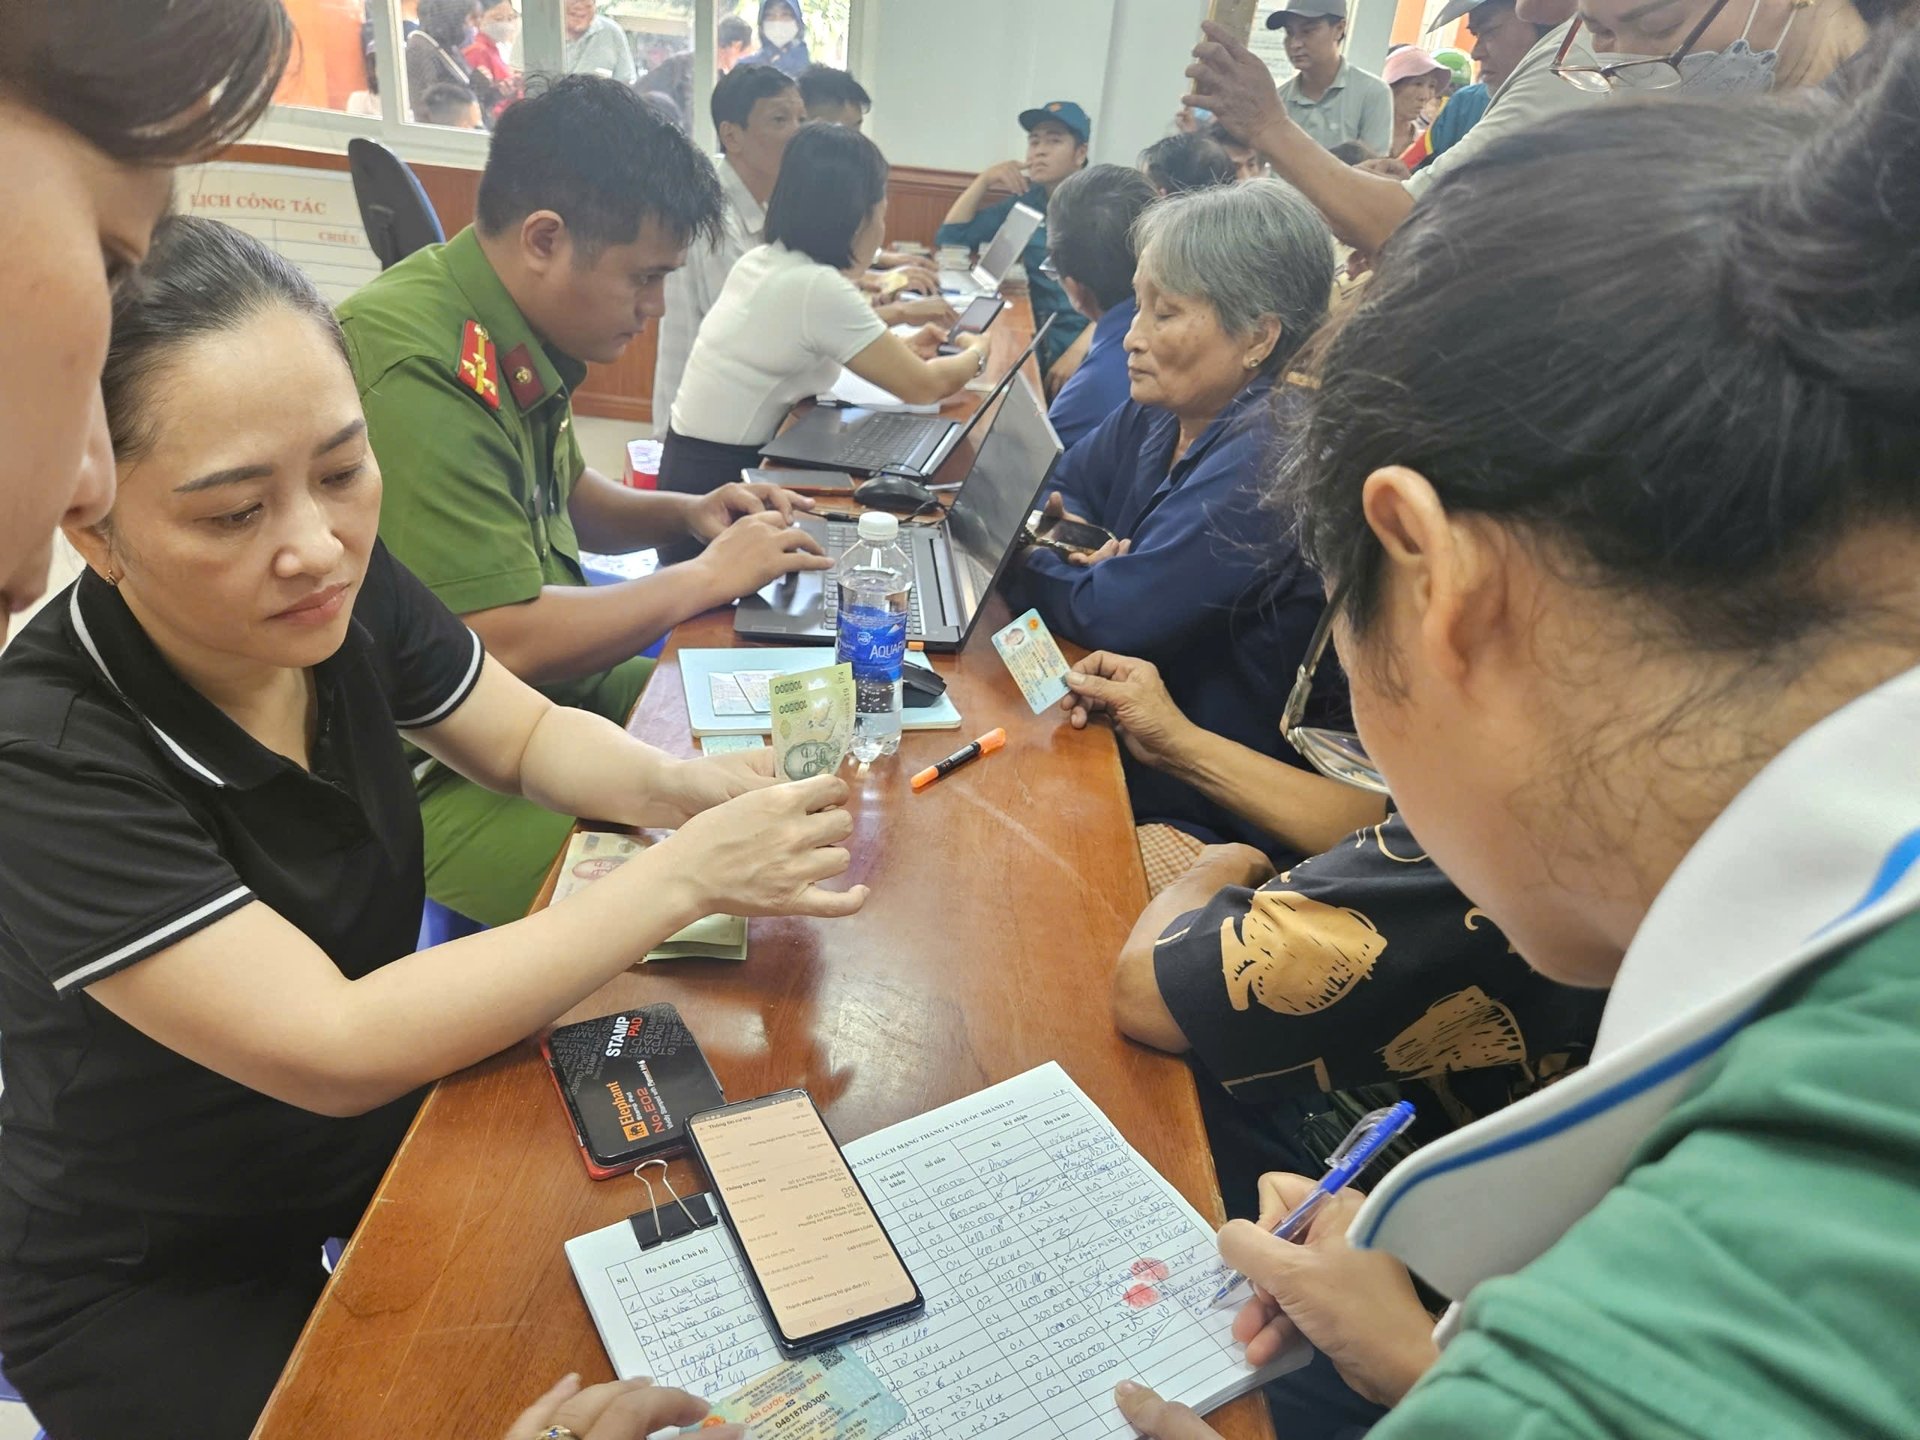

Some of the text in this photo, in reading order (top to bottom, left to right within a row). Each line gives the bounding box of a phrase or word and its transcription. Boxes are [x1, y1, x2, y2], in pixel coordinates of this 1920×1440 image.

[191, 192, 328, 214] LỊCH CÔNG TÁC
[604, 1014, 631, 1058] STAMP
[626, 1015, 643, 1037] PAD
[604, 1079, 635, 1125] Elephant
[644, 1244, 709, 1276] Họ và tên Chủ hộ
[760, 1393, 785, 1413] CƯỚC
[783, 1380, 807, 1399] CÔNG
[805, 1370, 823, 1385] DÂN
[773, 1388, 831, 1429] 048187003091
[815, 1404, 835, 1421] LOAN
